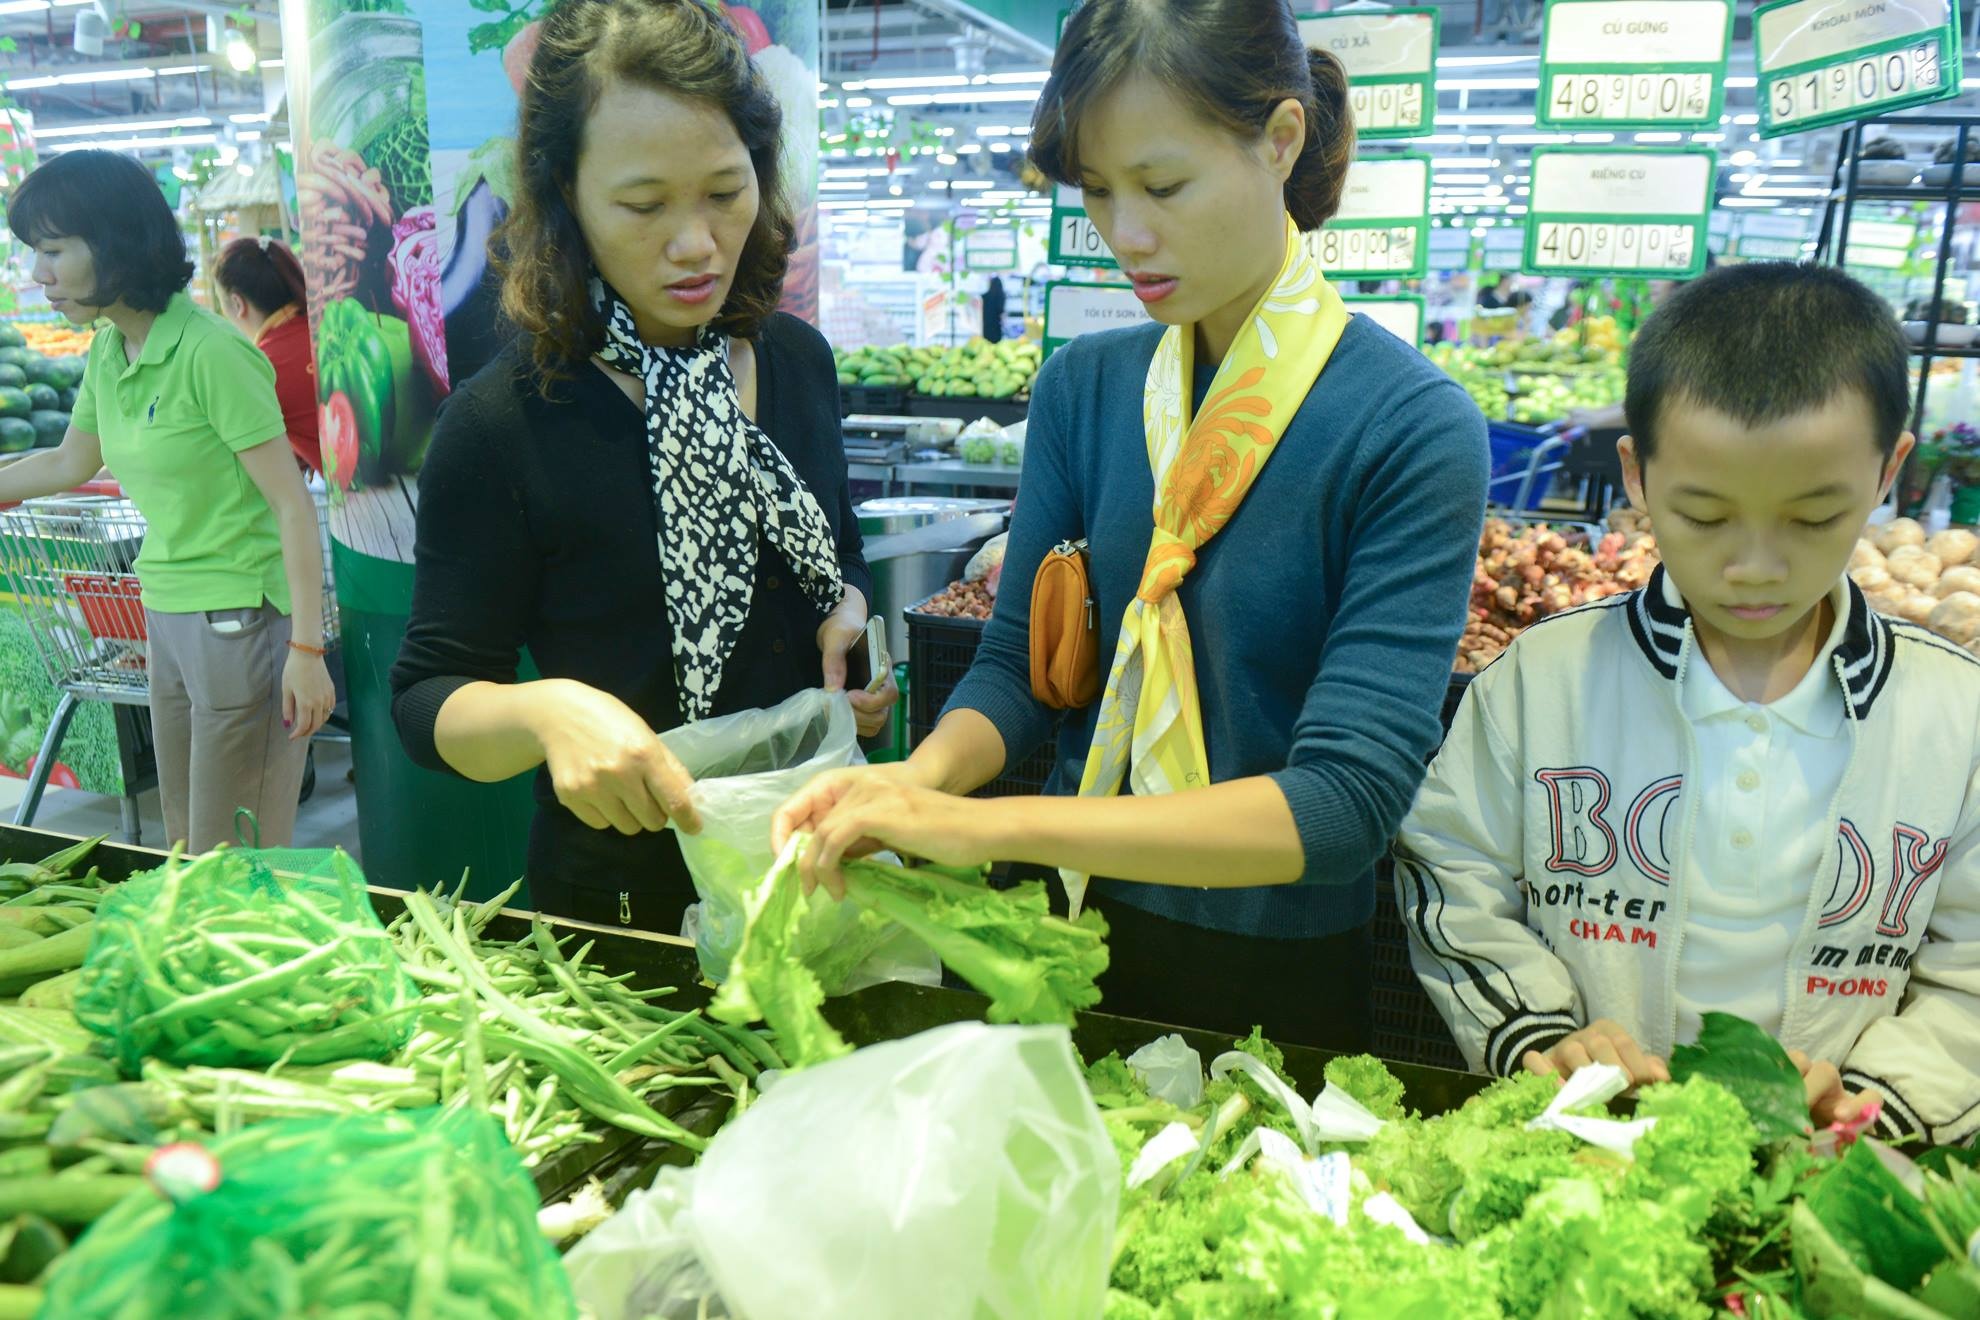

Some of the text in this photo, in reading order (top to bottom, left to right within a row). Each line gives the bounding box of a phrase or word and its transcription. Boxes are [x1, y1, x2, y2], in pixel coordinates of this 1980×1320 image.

[1812, 13, 1851, 32] KHOAI
[1067, 219, 1100, 251] 16
[1570, 919, 1657, 949] CHAM
[1807, 975, 1888, 997] PIONS
